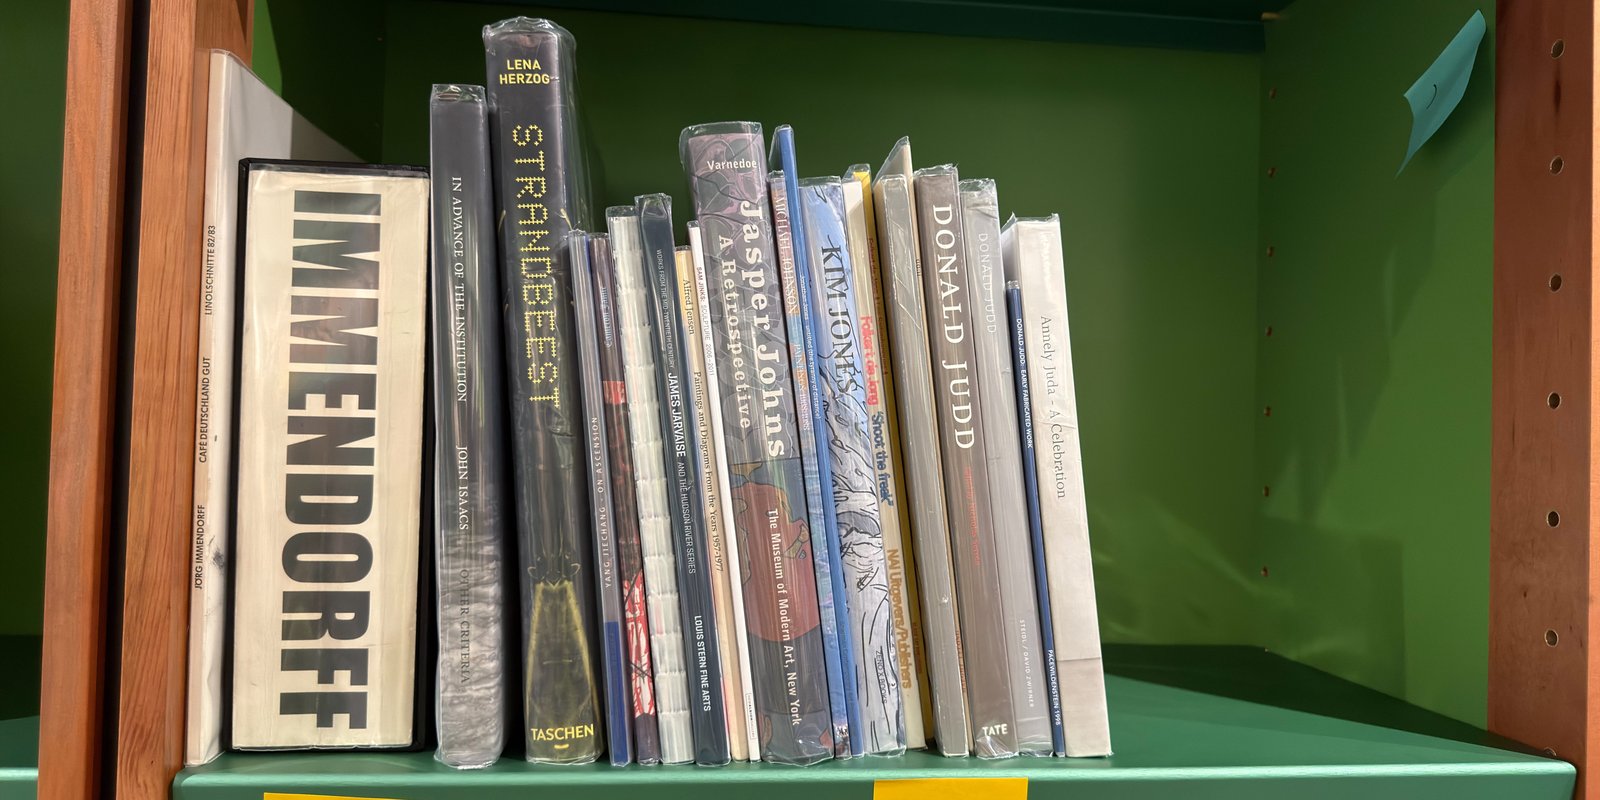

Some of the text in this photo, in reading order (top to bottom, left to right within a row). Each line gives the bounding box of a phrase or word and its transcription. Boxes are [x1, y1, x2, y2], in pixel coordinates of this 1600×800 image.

[499, 73, 550, 84] HERZOG
[506, 58, 542, 70] LENA
[706, 158, 758, 170] Varnedoe
[205, 224, 215, 315] LINOLSCHNITTE 82/83
[502, 123, 570, 411] STRANDBEEST
[656, 249, 664, 269] WORKS
[774, 195, 798, 314] MICHAEL JOHNSON
[931, 203, 965, 345] DONALD
[452, 176, 466, 402] IN ADVANCE OF THE INSTITUTION
[658, 270, 666, 287] FROM
[697, 281, 706, 302] JINKS:
[977, 232, 996, 334] DONALD JUDD
[682, 279, 696, 335] Alfred Jensen
[700, 304, 710, 341] SCULPTURE
[820, 244, 858, 394] KIM JONES
[718, 234, 753, 429] A Retrospective
[734, 199, 789, 458] Jasper Johns
[805, 325, 813, 349] untitled
[1015, 317, 1024, 346] DONALD
[1037, 314, 1055, 363] Annely
[202, 356, 210, 375] GUT
[808, 361, 816, 384] tyranny
[1019, 369, 1028, 389] EARLY
[1042, 364, 1059, 396] Juda
[811, 383, 818, 391] of
[812, 391, 821, 420] distance)
[942, 357, 975, 450] JUDD
[199, 377, 209, 439] DEUTSCHLAND
[1021, 389, 1031, 428] FABRICATED
[1048, 408, 1059, 420] A
[591, 415, 602, 474] ASCENSION
[1025, 428, 1033, 449] WORK
[279, 190, 382, 730] IMMENDORFF
[667, 371, 696, 574] JAMES JARVAISE AND THE HUDSON RIVER SERIES
[691, 370, 723, 573] Paintings and Diagrams From the Years 1957-1977
[875, 451, 889, 471] the
[1049, 422, 1069, 500] Celebration
[456, 445, 468, 530] JOHN ISAACS
[596, 478, 603, 493] ON
[194, 504, 205, 563] IMMENDORFF
[599, 505, 609, 556] JIECHANG
[603, 560, 611, 587] YANG
[458, 569, 470, 683] OTHER CRITERIA
[768, 507, 802, 725] The Museum of Modern Art, New York
[1019, 619, 1027, 643] STEIDL
[694, 615, 710, 711] LOUIS STERN FINE ARTS
[1022, 651, 1030, 674] DAVID
[1025, 675, 1034, 708] ZWIRNER
[1046, 649, 1061, 726] PACEWILDENSTEIN 1998
[530, 723, 594, 741] TASCHEN
[982, 724, 1008, 736] TATE
